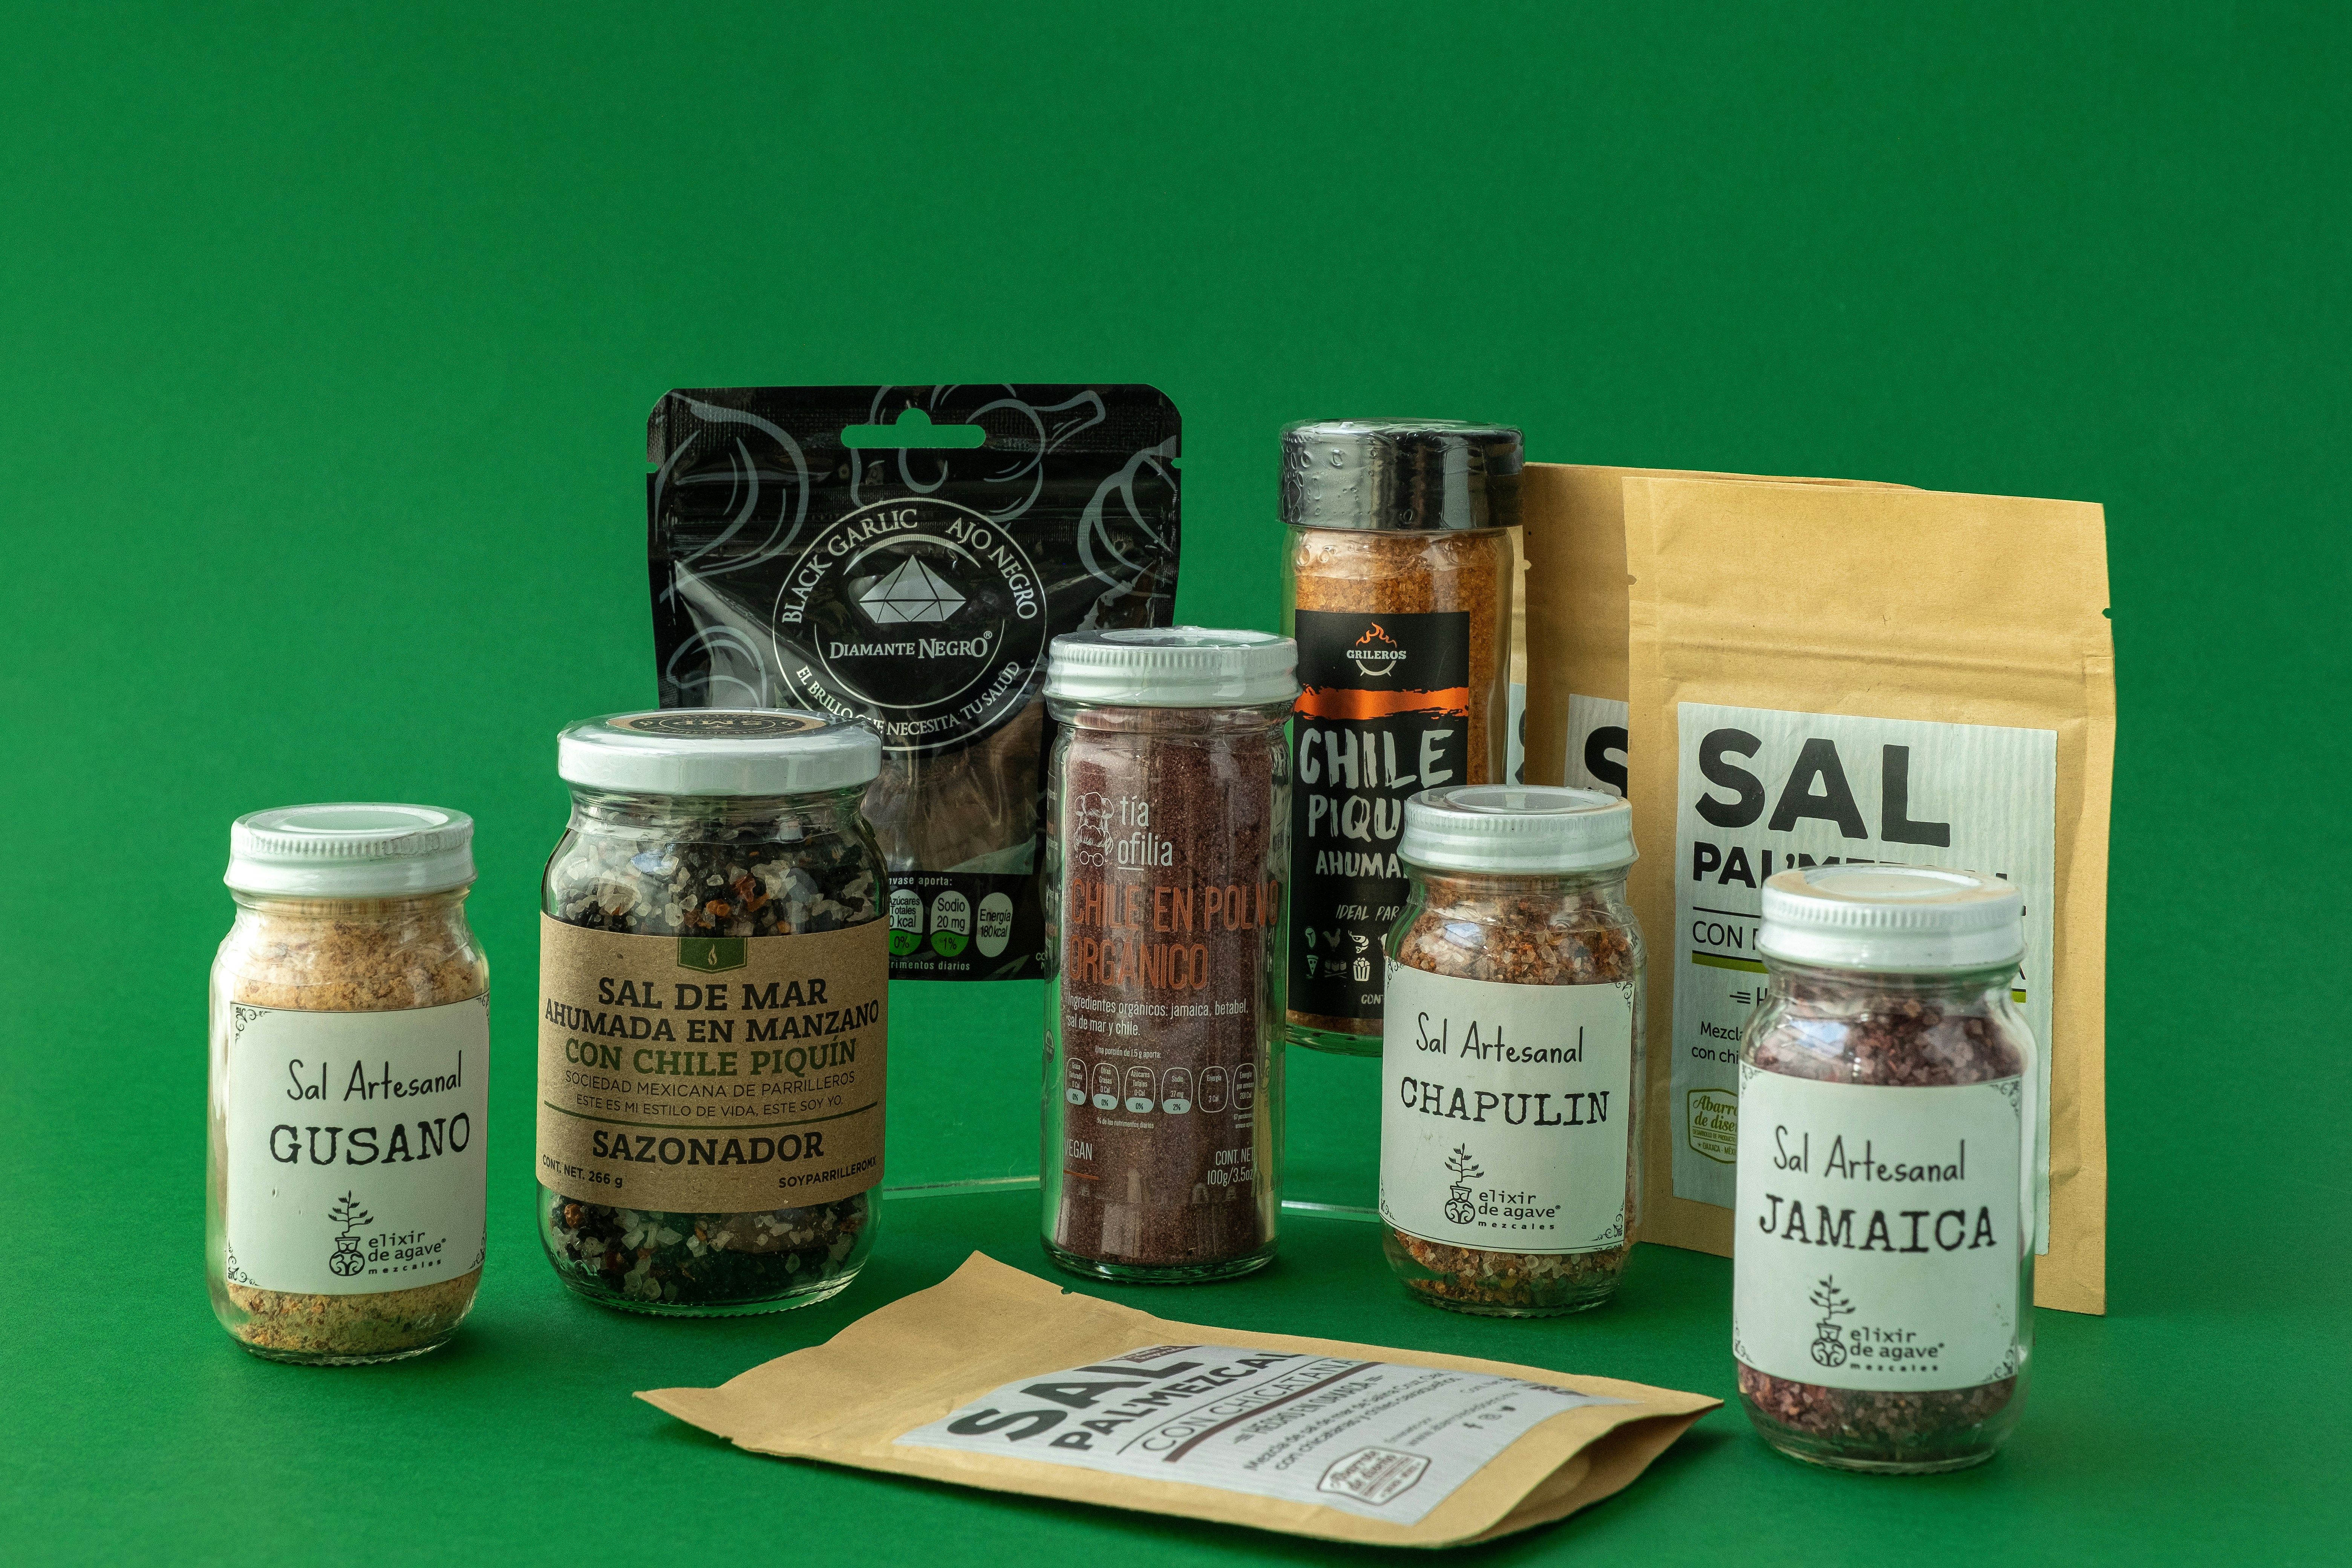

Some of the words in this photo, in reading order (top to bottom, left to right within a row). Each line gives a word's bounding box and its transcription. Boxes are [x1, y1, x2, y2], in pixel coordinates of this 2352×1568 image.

[782, 555, 832, 623] BLACK
[828, 509, 917, 556] GARLIC
[948, 518, 991, 549] AJO
[989, 545, 1037, 619] NEGRO
[830, 642, 915, 659] DIAMANTE
[1346, 650, 1406, 660] GRILEROS
[796, 665, 808, 686] EL
[807, 682, 853, 718] BRILLO
[887, 714, 960, 736] NECESITA
[960, 699, 982, 720] TU
[982, 662, 1019, 706] SALUD
[1300, 728, 1454, 789] CHILE
[1695, 728, 1951, 847] SAL
[1120, 796, 1149, 827] tía
[1118, 832, 1173, 866] ofilia
[1316, 850, 1410, 879] AHUMA
[919, 877, 952, 887] aporta:
[890, 905, 916, 915] Totales
[937, 898, 965, 913] Sodio
[980, 909, 1011, 926] Energía
[1072, 878, 1141, 931] CHILE
[1154, 886, 1193, 933] EN
[1204, 879, 1279, 931] POLVO
[1336, 905, 1369, 921] IDEAL
[897, 915, 916, 928] kcal
[937, 916, 949, 928] 20
[951, 918, 965, 931] mg
[1693, 920, 1743, 949] CON
[894, 936, 910, 949] 0%
[944, 937, 957, 950] 1%
[938, 961, 971, 971] diarios
[1069, 933, 1208, 990] ORGÁNICO
[599, 977, 663, 1009] SAL
[674, 984, 728, 1011] DE
[741, 978, 828, 1011] MAR
[1067, 990, 1116, 1013] Ingredientes
[1118, 1001, 1168, 1018] orgánicos:
[1170, 1003, 1211, 1020] jamaica,
[545, 998, 676, 1042] AHUMADA
[687, 1019, 735, 1043] EN
[746, 999, 879, 1043] MANZANO
[1067, 1013, 1077, 1028] sal
[1079, 1014, 1087, 1030] de
[1090, 1020, 1107, 1032] mar
[1109, 1022, 1113, 1036] y
[1116, 1020, 1141, 1036] chile.
[1416, 1012, 1447, 1054] Sal
[1460, 1020, 1583, 1063] Artesanal
[565, 1039, 623, 1070] CON
[633, 1047, 738, 1076] CHILE
[753, 1036, 857, 1077] PIQUÍN
[1692, 1046, 1715, 1061] con
[287, 1059, 327, 1100] Sal
[343, 1050, 462, 1101] Artesanal
[565, 1070, 632, 1093] SOCIEDAD
[637, 1082, 726, 1097] MEXICANA
[733, 1084, 755, 1097] DE
[761, 1070, 855, 1097] PARRILLEROS
[577, 1094, 603, 1109] ESTE
[606, 1098, 621, 1112] ES
[624, 1101, 639, 1113] MI
[643, 1103, 691, 1116] ESTILO
[697, 1105, 717, 1117] DE
[721, 1105, 759, 1118] VIDA,
[763, 1102, 796, 1116] ESTE
[800, 1098, 825, 1112] SOY
[1401, 1076, 1610, 1126] CHAPULIN
[1694, 1110, 1708, 1127] de
[1710, 1114, 1737, 1132] dise
[270, 1112, 470, 1165] GUSANO
[593, 1130, 824, 1165] SAZONADOR
[1064, 1138, 1092, 1161] VEGAN
[1216, 1149, 1239, 1165] CONT.
[1774, 1125, 1809, 1173] Sal
[1825, 1135, 1965, 1182] Artesanal
[543, 1154, 562, 1173] CONT.
[564, 1165, 585, 1181] NET.
[589, 1169, 611, 1184] 266
[615, 1176, 623, 1188] g
[778, 1155, 877, 1188] SOYPARRILLEROMX
[1478, 1202, 1498, 1216] de
[1479, 1189, 1536, 1204] elixir
[1478, 1221, 1554, 1230] mezcales
[1759, 1194, 1997, 1253] JAMAICA
[369, 1230, 425, 1248] elixir
[368, 1248, 389, 1262] de
[368, 1259, 441, 1274] mezcales
[1851, 1326, 1917, 1343] elixir
[1850, 1342, 1873, 1357] de
[947, 1361, 1204, 1442] SAL
[1050, 1353, 1306, 1451] PAL'MEZCAL
[1142, 1416, 1218, 1451] CON
[1210, 1360, 1359, 1415] CHICATANA
